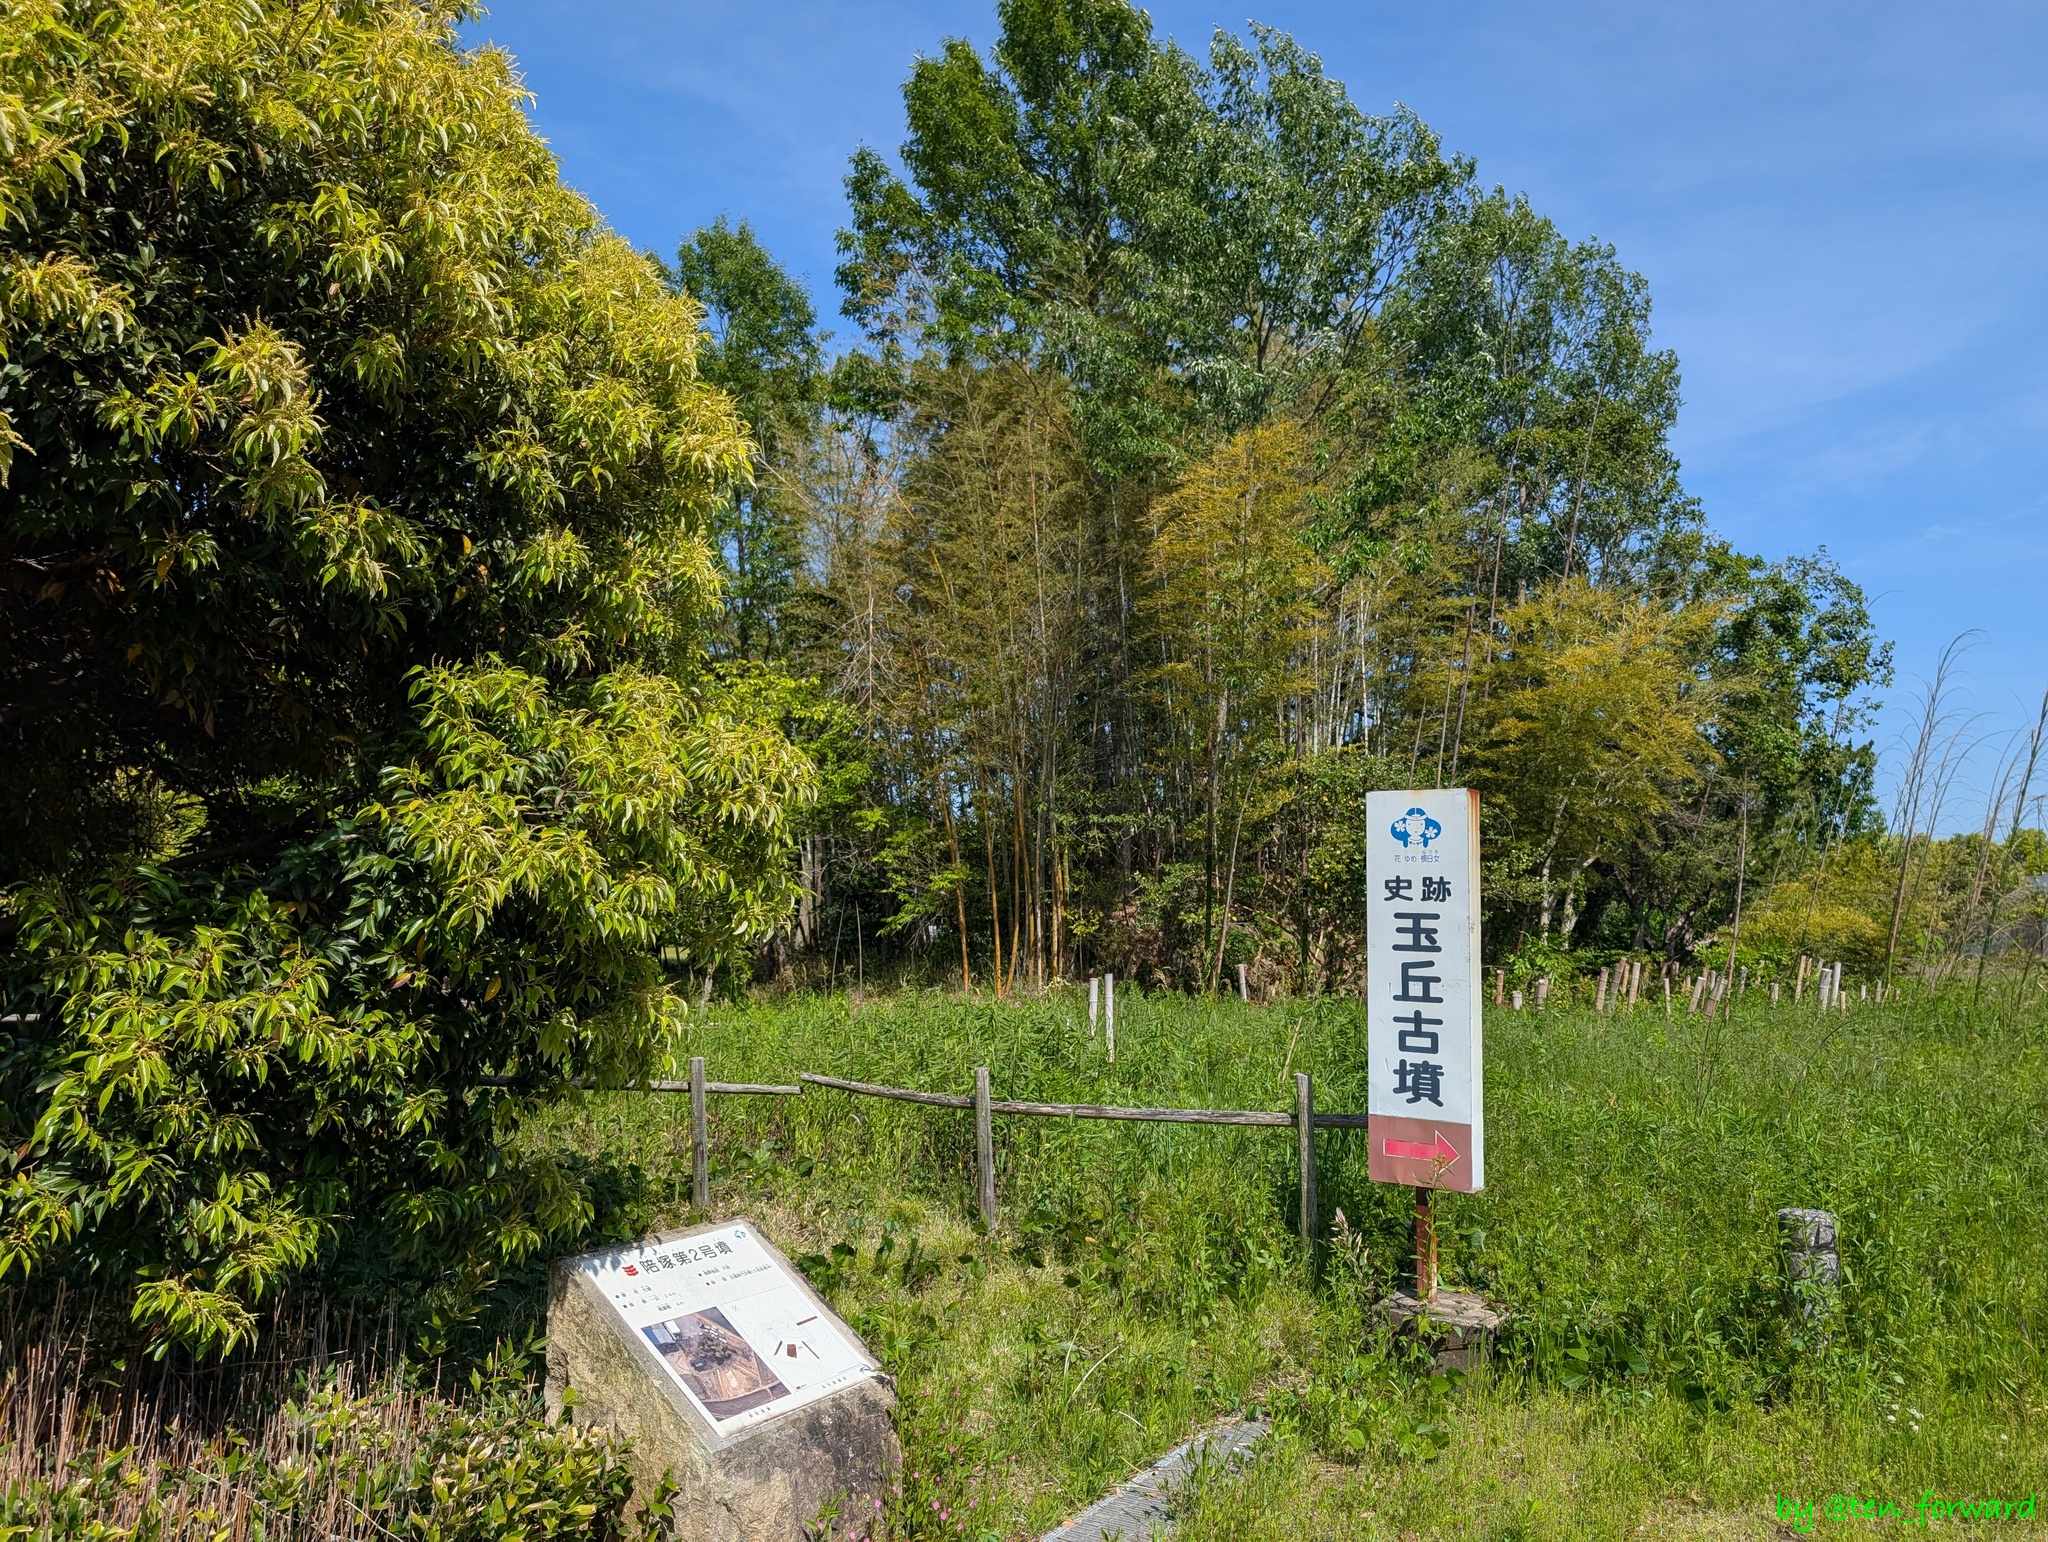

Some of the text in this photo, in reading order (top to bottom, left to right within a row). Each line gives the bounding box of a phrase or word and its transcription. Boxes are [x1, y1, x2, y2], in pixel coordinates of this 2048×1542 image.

[1383, 875, 1452, 902] 史跡
[1391, 911, 1445, 1108] 玉丘古墳
